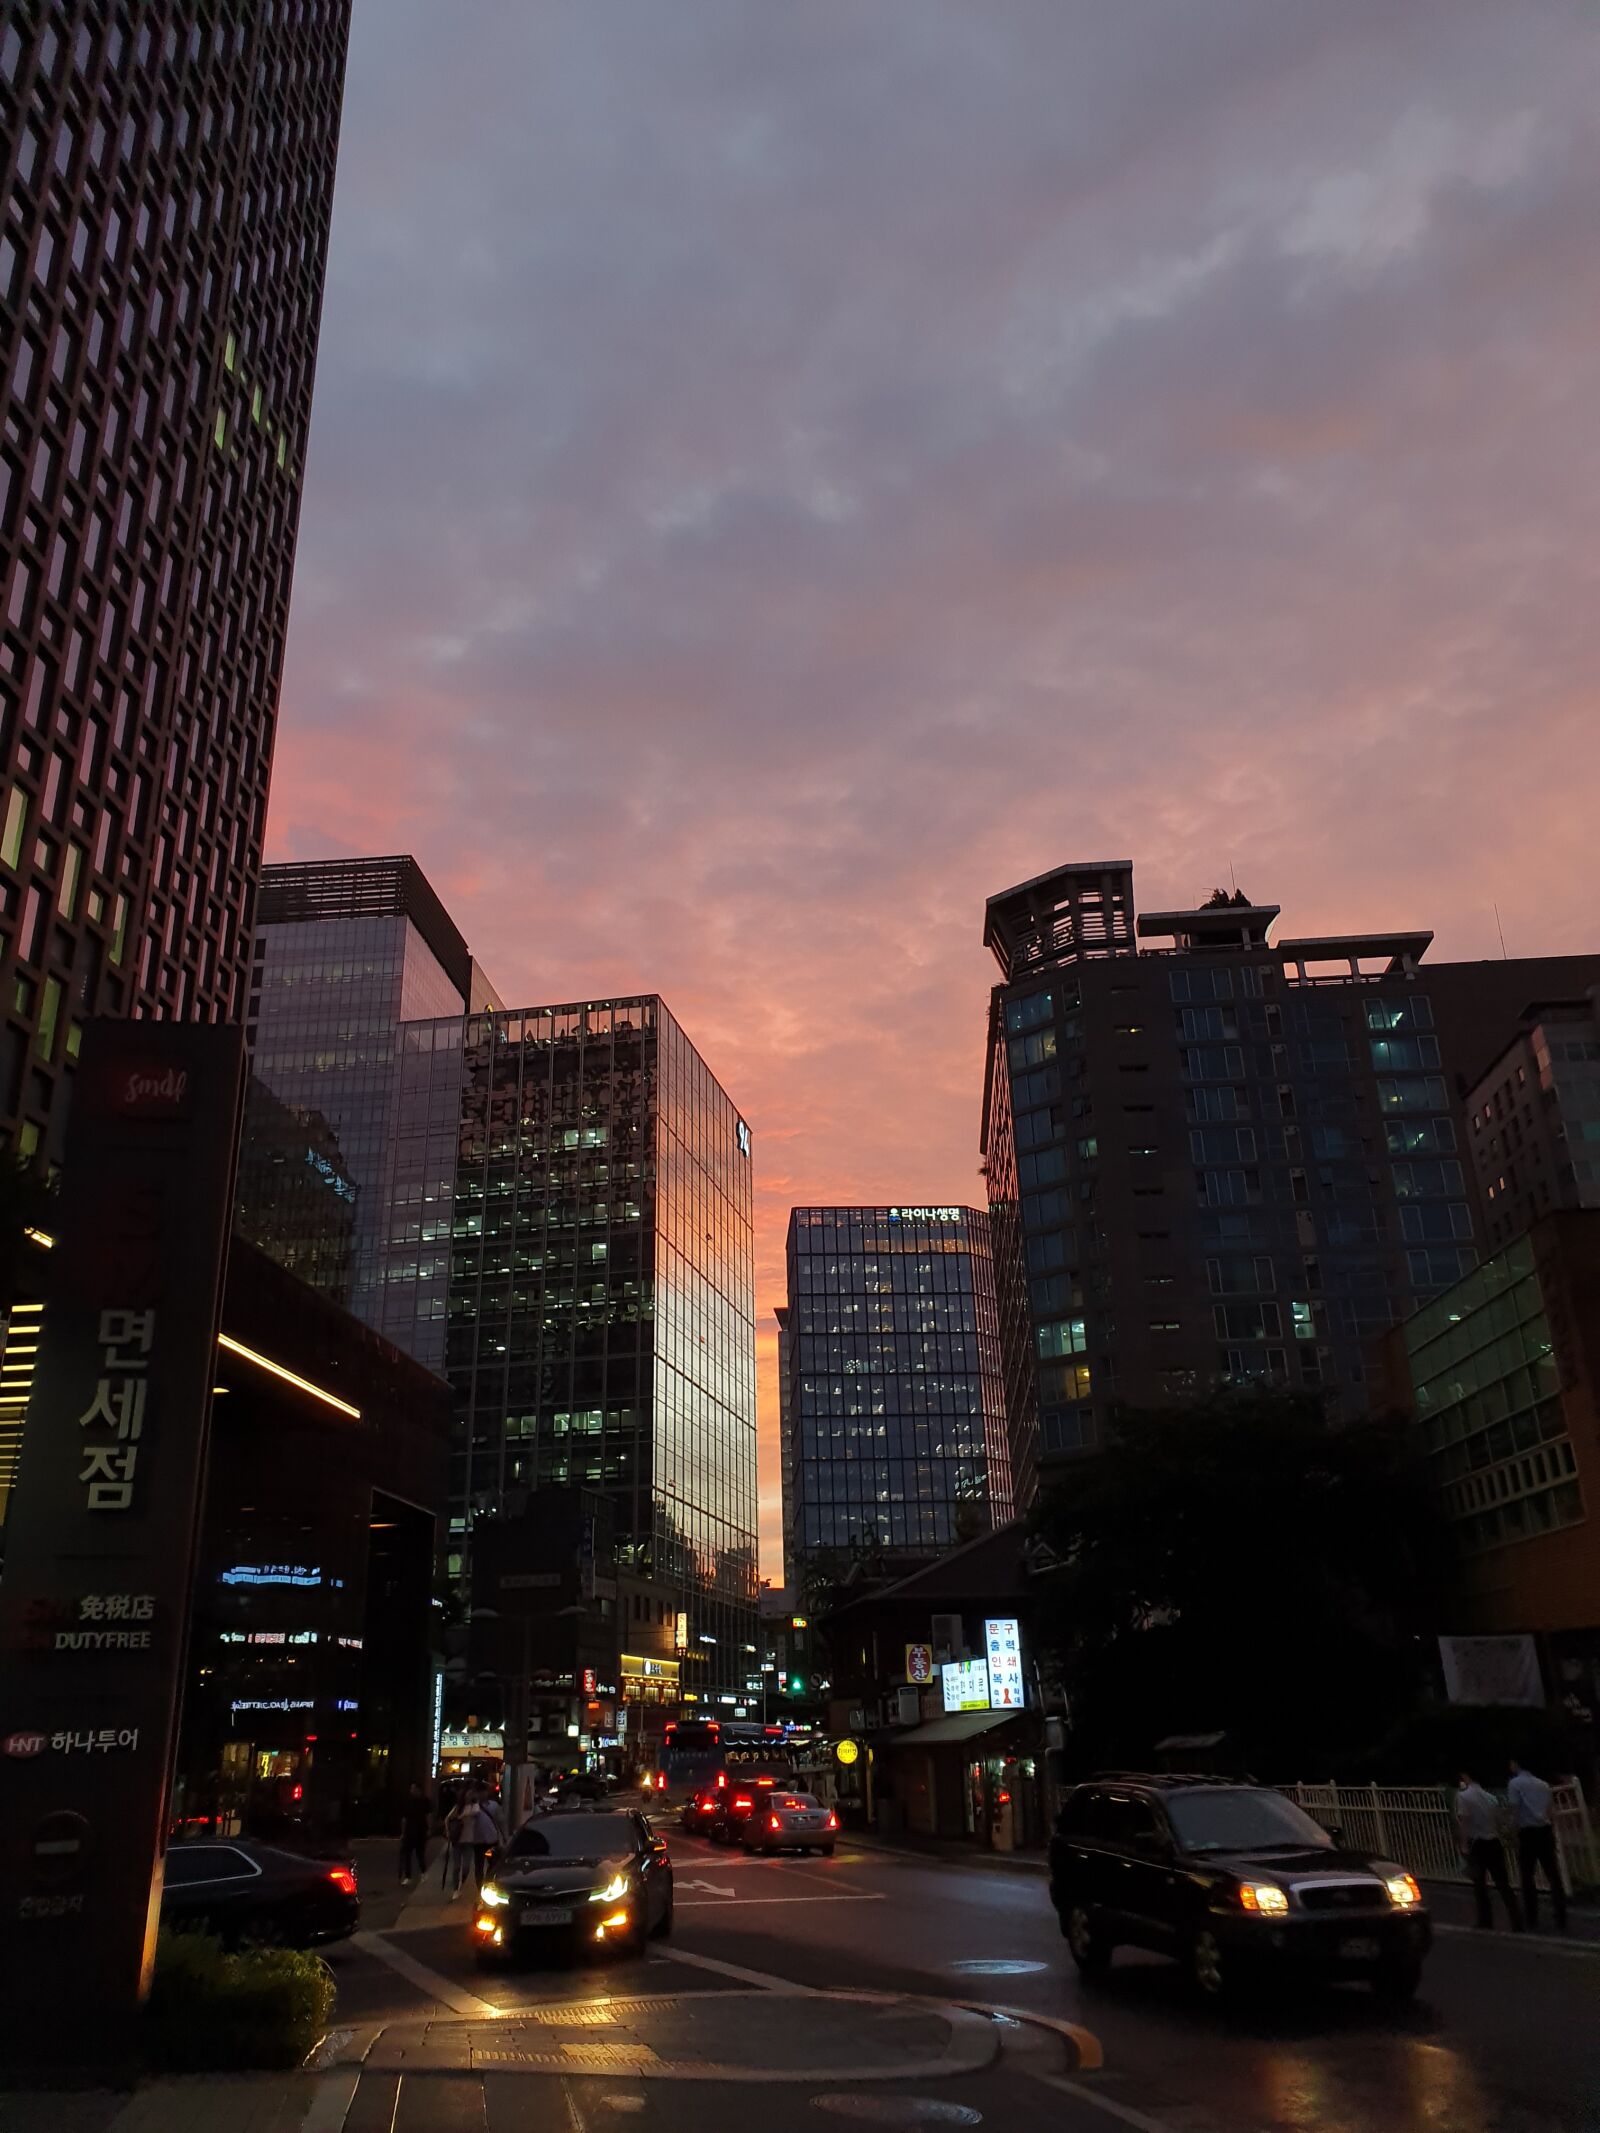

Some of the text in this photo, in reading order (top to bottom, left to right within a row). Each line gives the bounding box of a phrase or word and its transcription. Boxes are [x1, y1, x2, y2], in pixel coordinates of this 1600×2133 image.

[901, 1207, 960, 1222] 라이나생명
[78, 1308, 156, 1509] 면세점
[988, 1623, 1014, 1635] 문구
[990, 1639, 1015, 1652] 출력
[911, 1647, 928, 1681] 부동산
[991, 1656, 1017, 1668] 인쇄
[993, 1672, 1019, 1684] 복사
[8, 1736, 45, 1753] HNT
[51, 1728, 139, 1754] 하나투어
